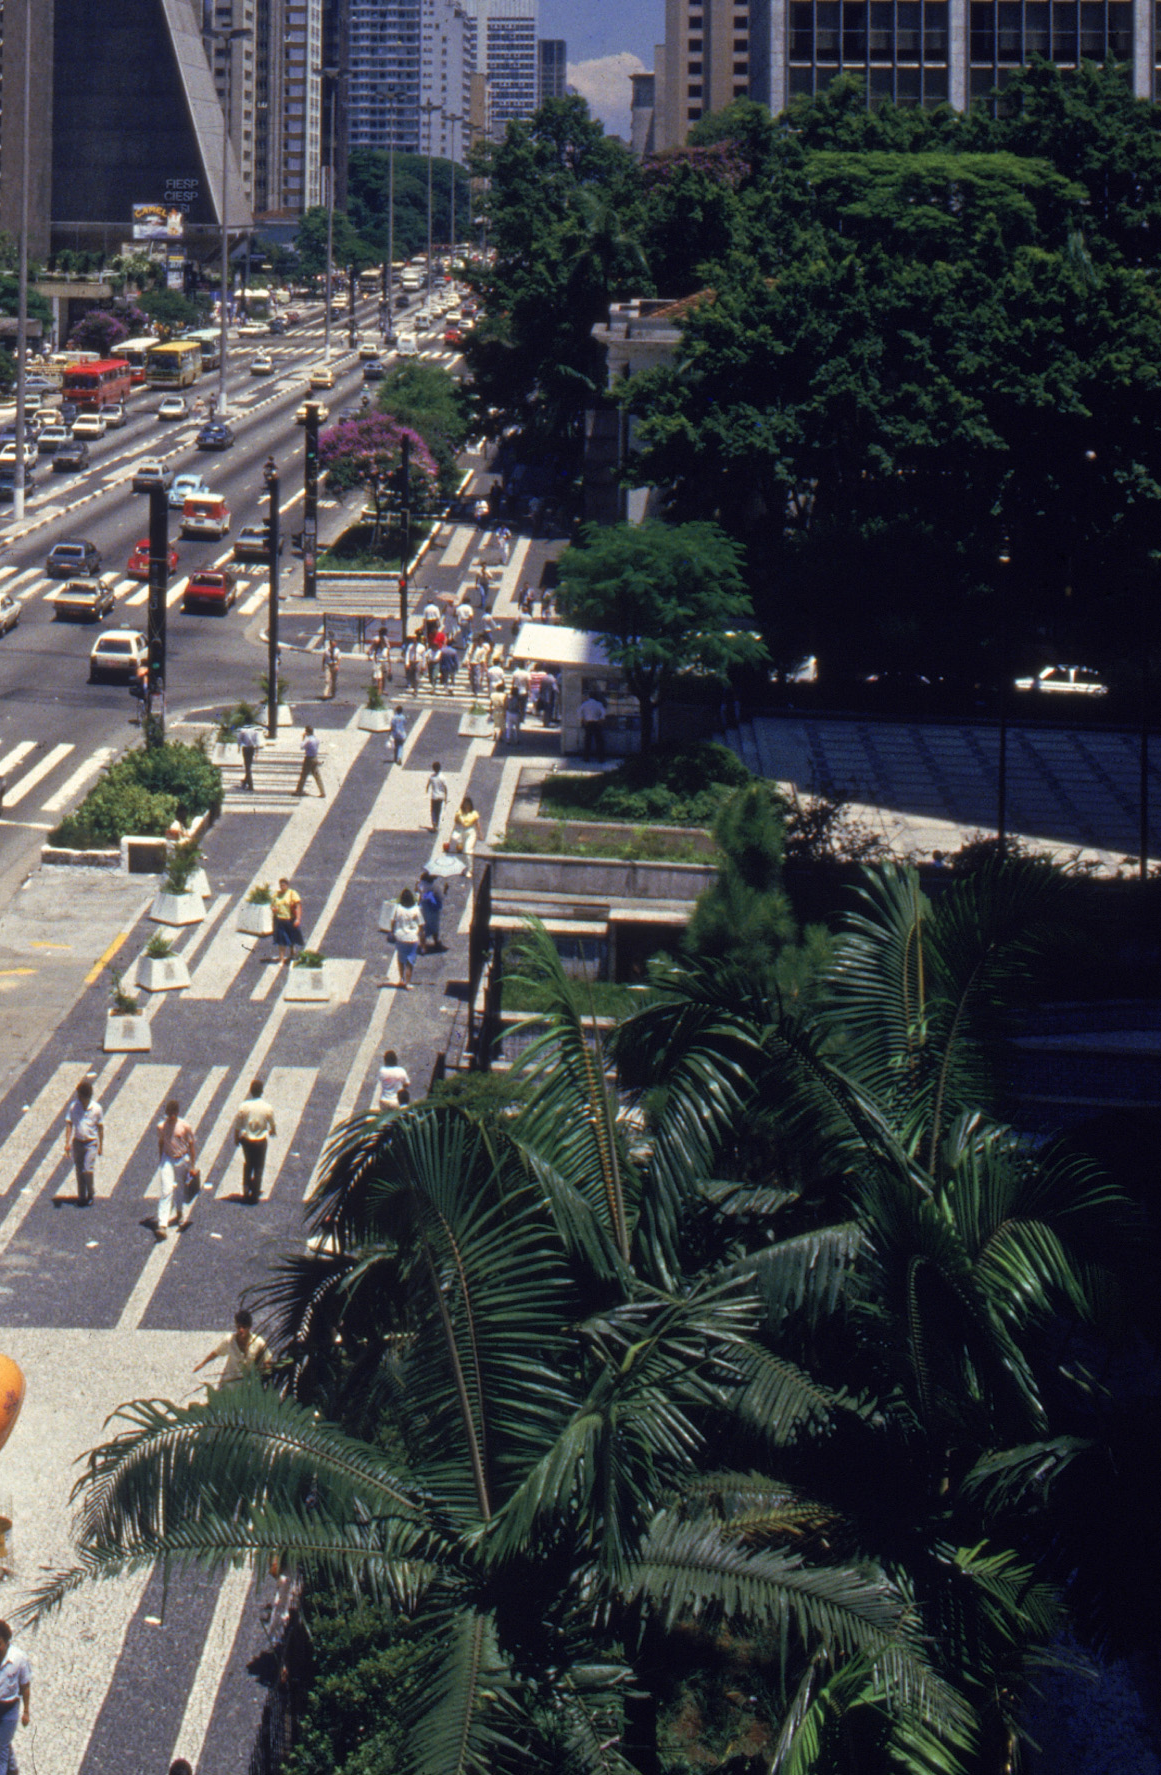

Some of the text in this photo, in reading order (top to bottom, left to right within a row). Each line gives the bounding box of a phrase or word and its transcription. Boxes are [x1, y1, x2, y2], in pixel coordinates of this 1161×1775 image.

[165, 178, 199, 189] FIESP
[163, 190, 199, 202] CIESP
[134, 206, 168, 218] CAMEL
